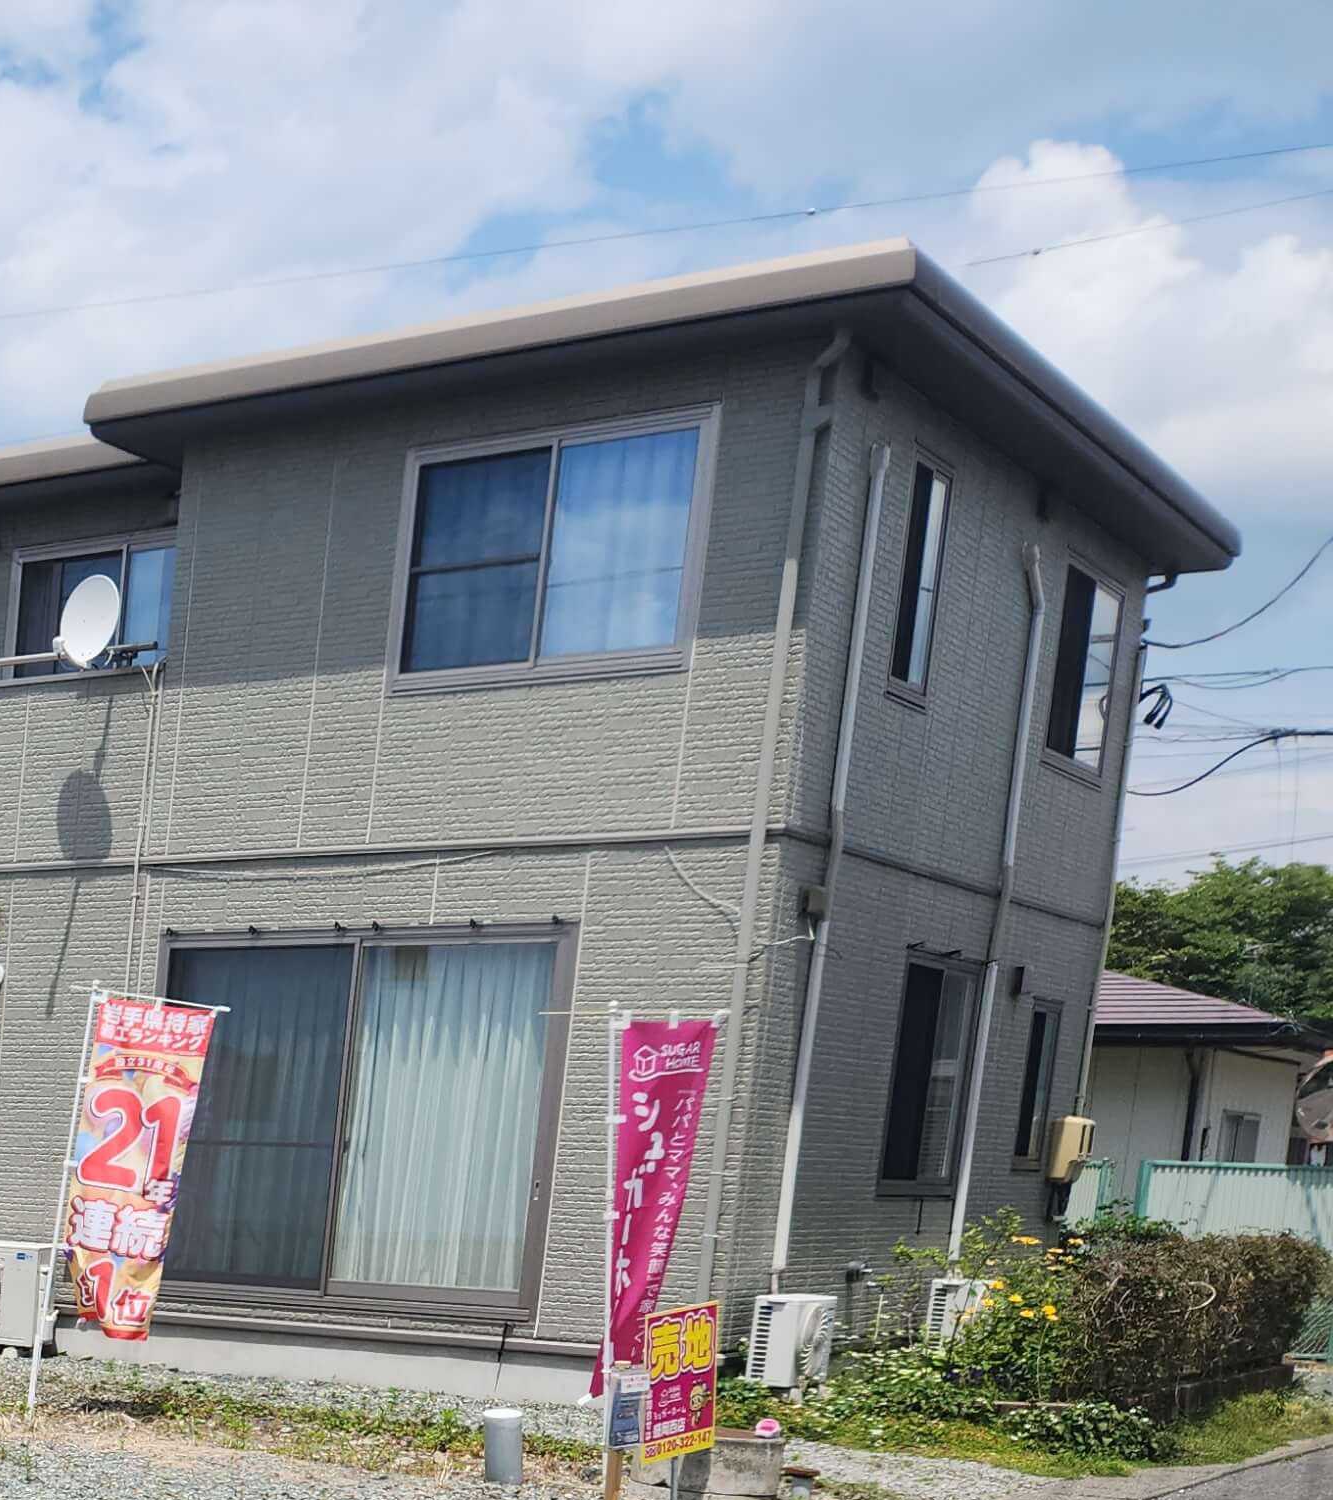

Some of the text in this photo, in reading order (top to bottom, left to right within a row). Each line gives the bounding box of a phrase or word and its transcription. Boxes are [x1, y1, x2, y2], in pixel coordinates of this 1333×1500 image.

[102, 1003, 210, 1036] 岩手県持家
[660, 1041, 701, 1057] SUGAR
[665, 1054, 700, 1068] HOME
[67, 1196, 170, 1260] 連続
[649, 1312, 713, 1381] 売地
